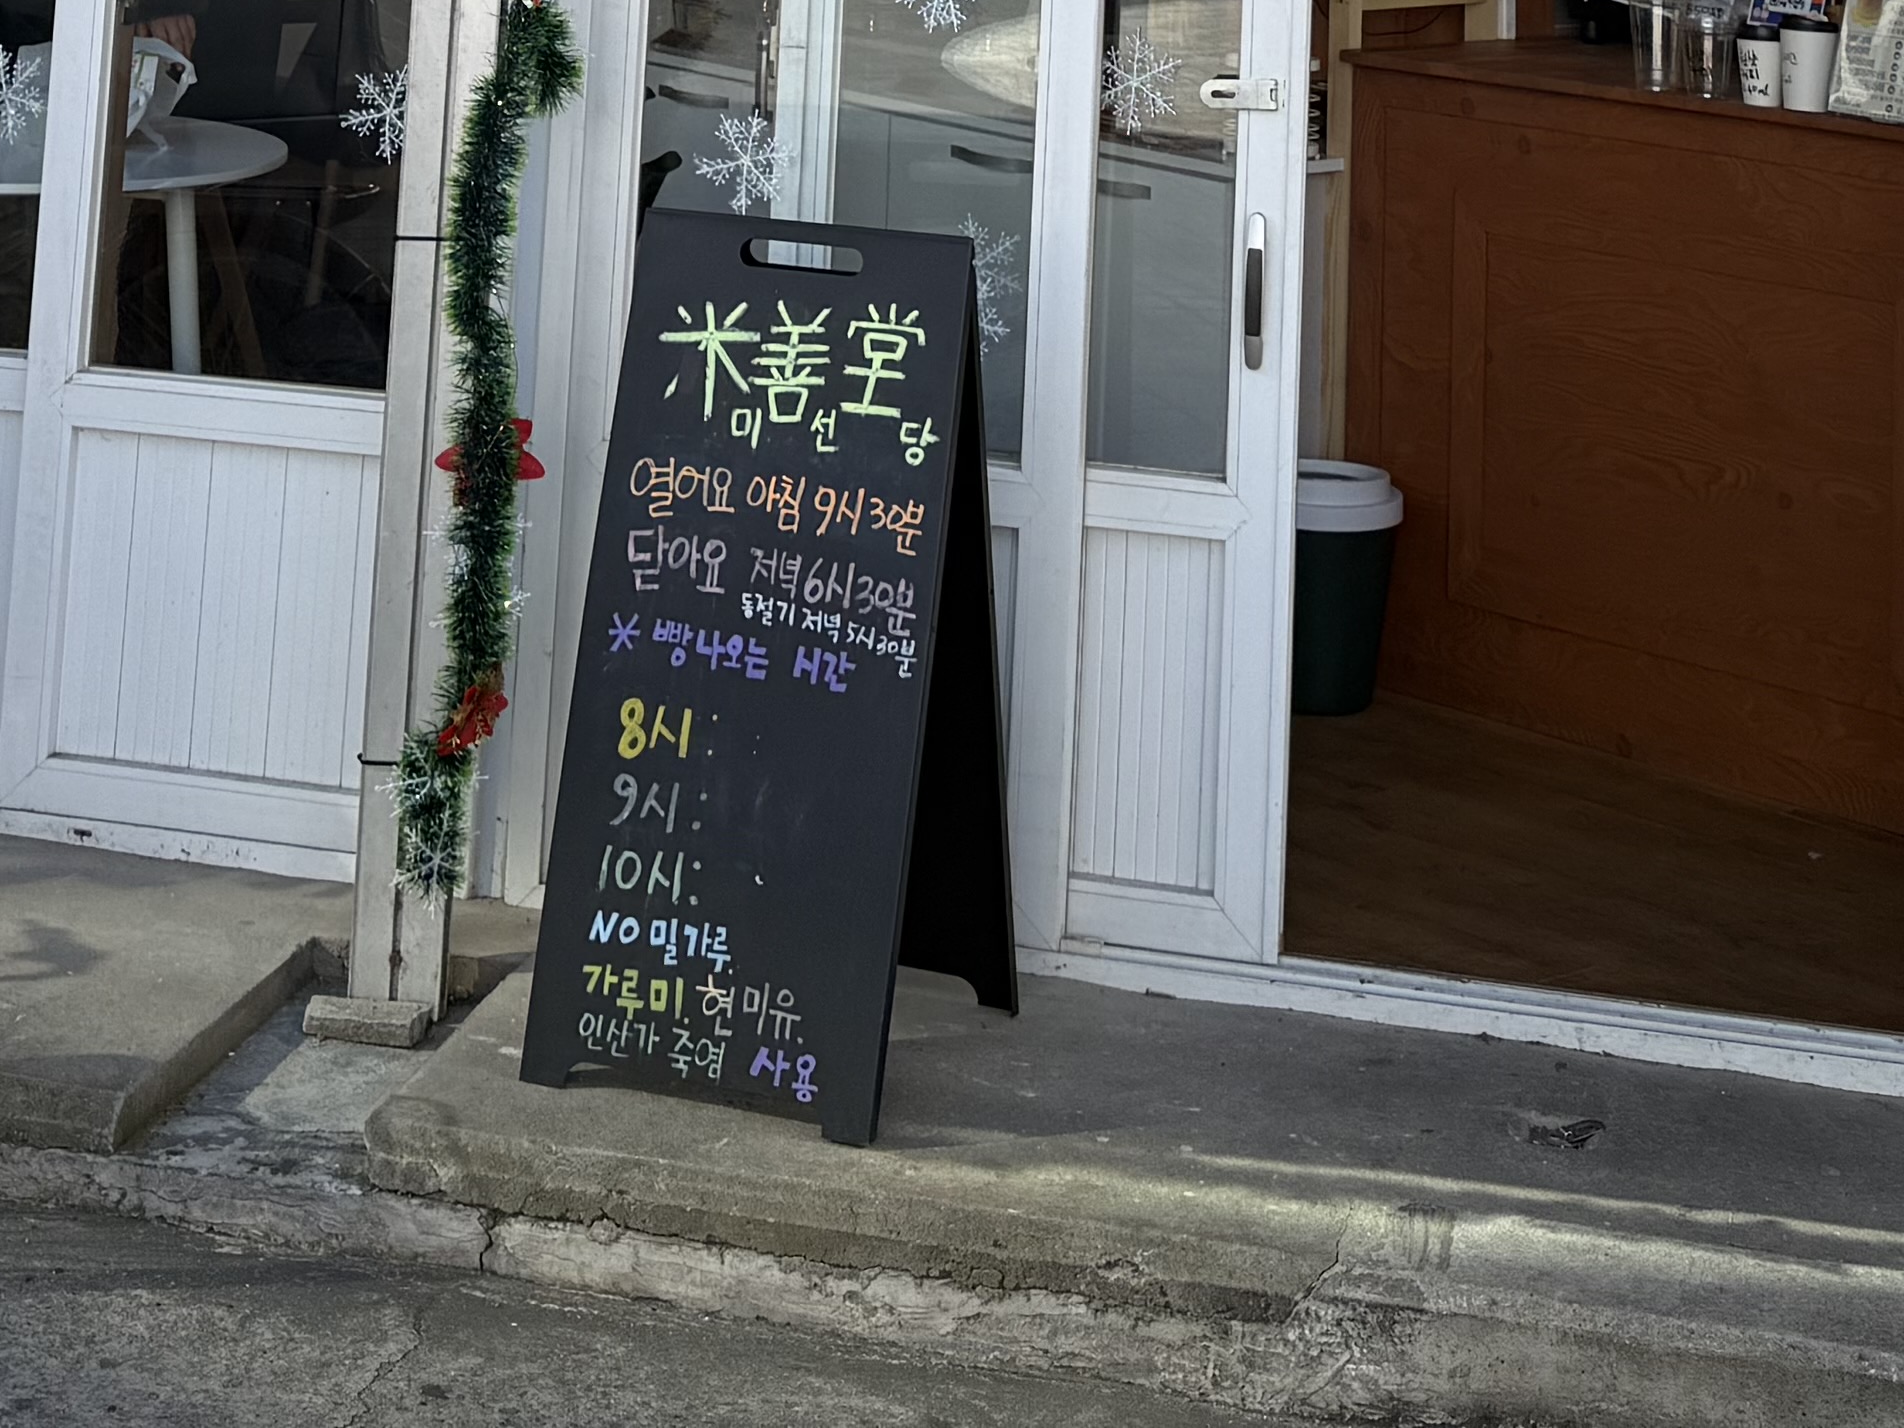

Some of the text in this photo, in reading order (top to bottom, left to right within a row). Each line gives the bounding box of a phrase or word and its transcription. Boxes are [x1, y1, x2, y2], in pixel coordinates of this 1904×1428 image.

[629, 456, 735, 519] 열어요
[746, 474, 806, 534] 아침
[626, 524, 728, 595] 닫아요
[740, 592, 796, 629] 동절기
[793, 645, 857, 694] 시간
[589, 910, 640, 946] NO
[667, 1026, 726, 1080] 죽염
[749, 1046, 819, 1103] 사용
